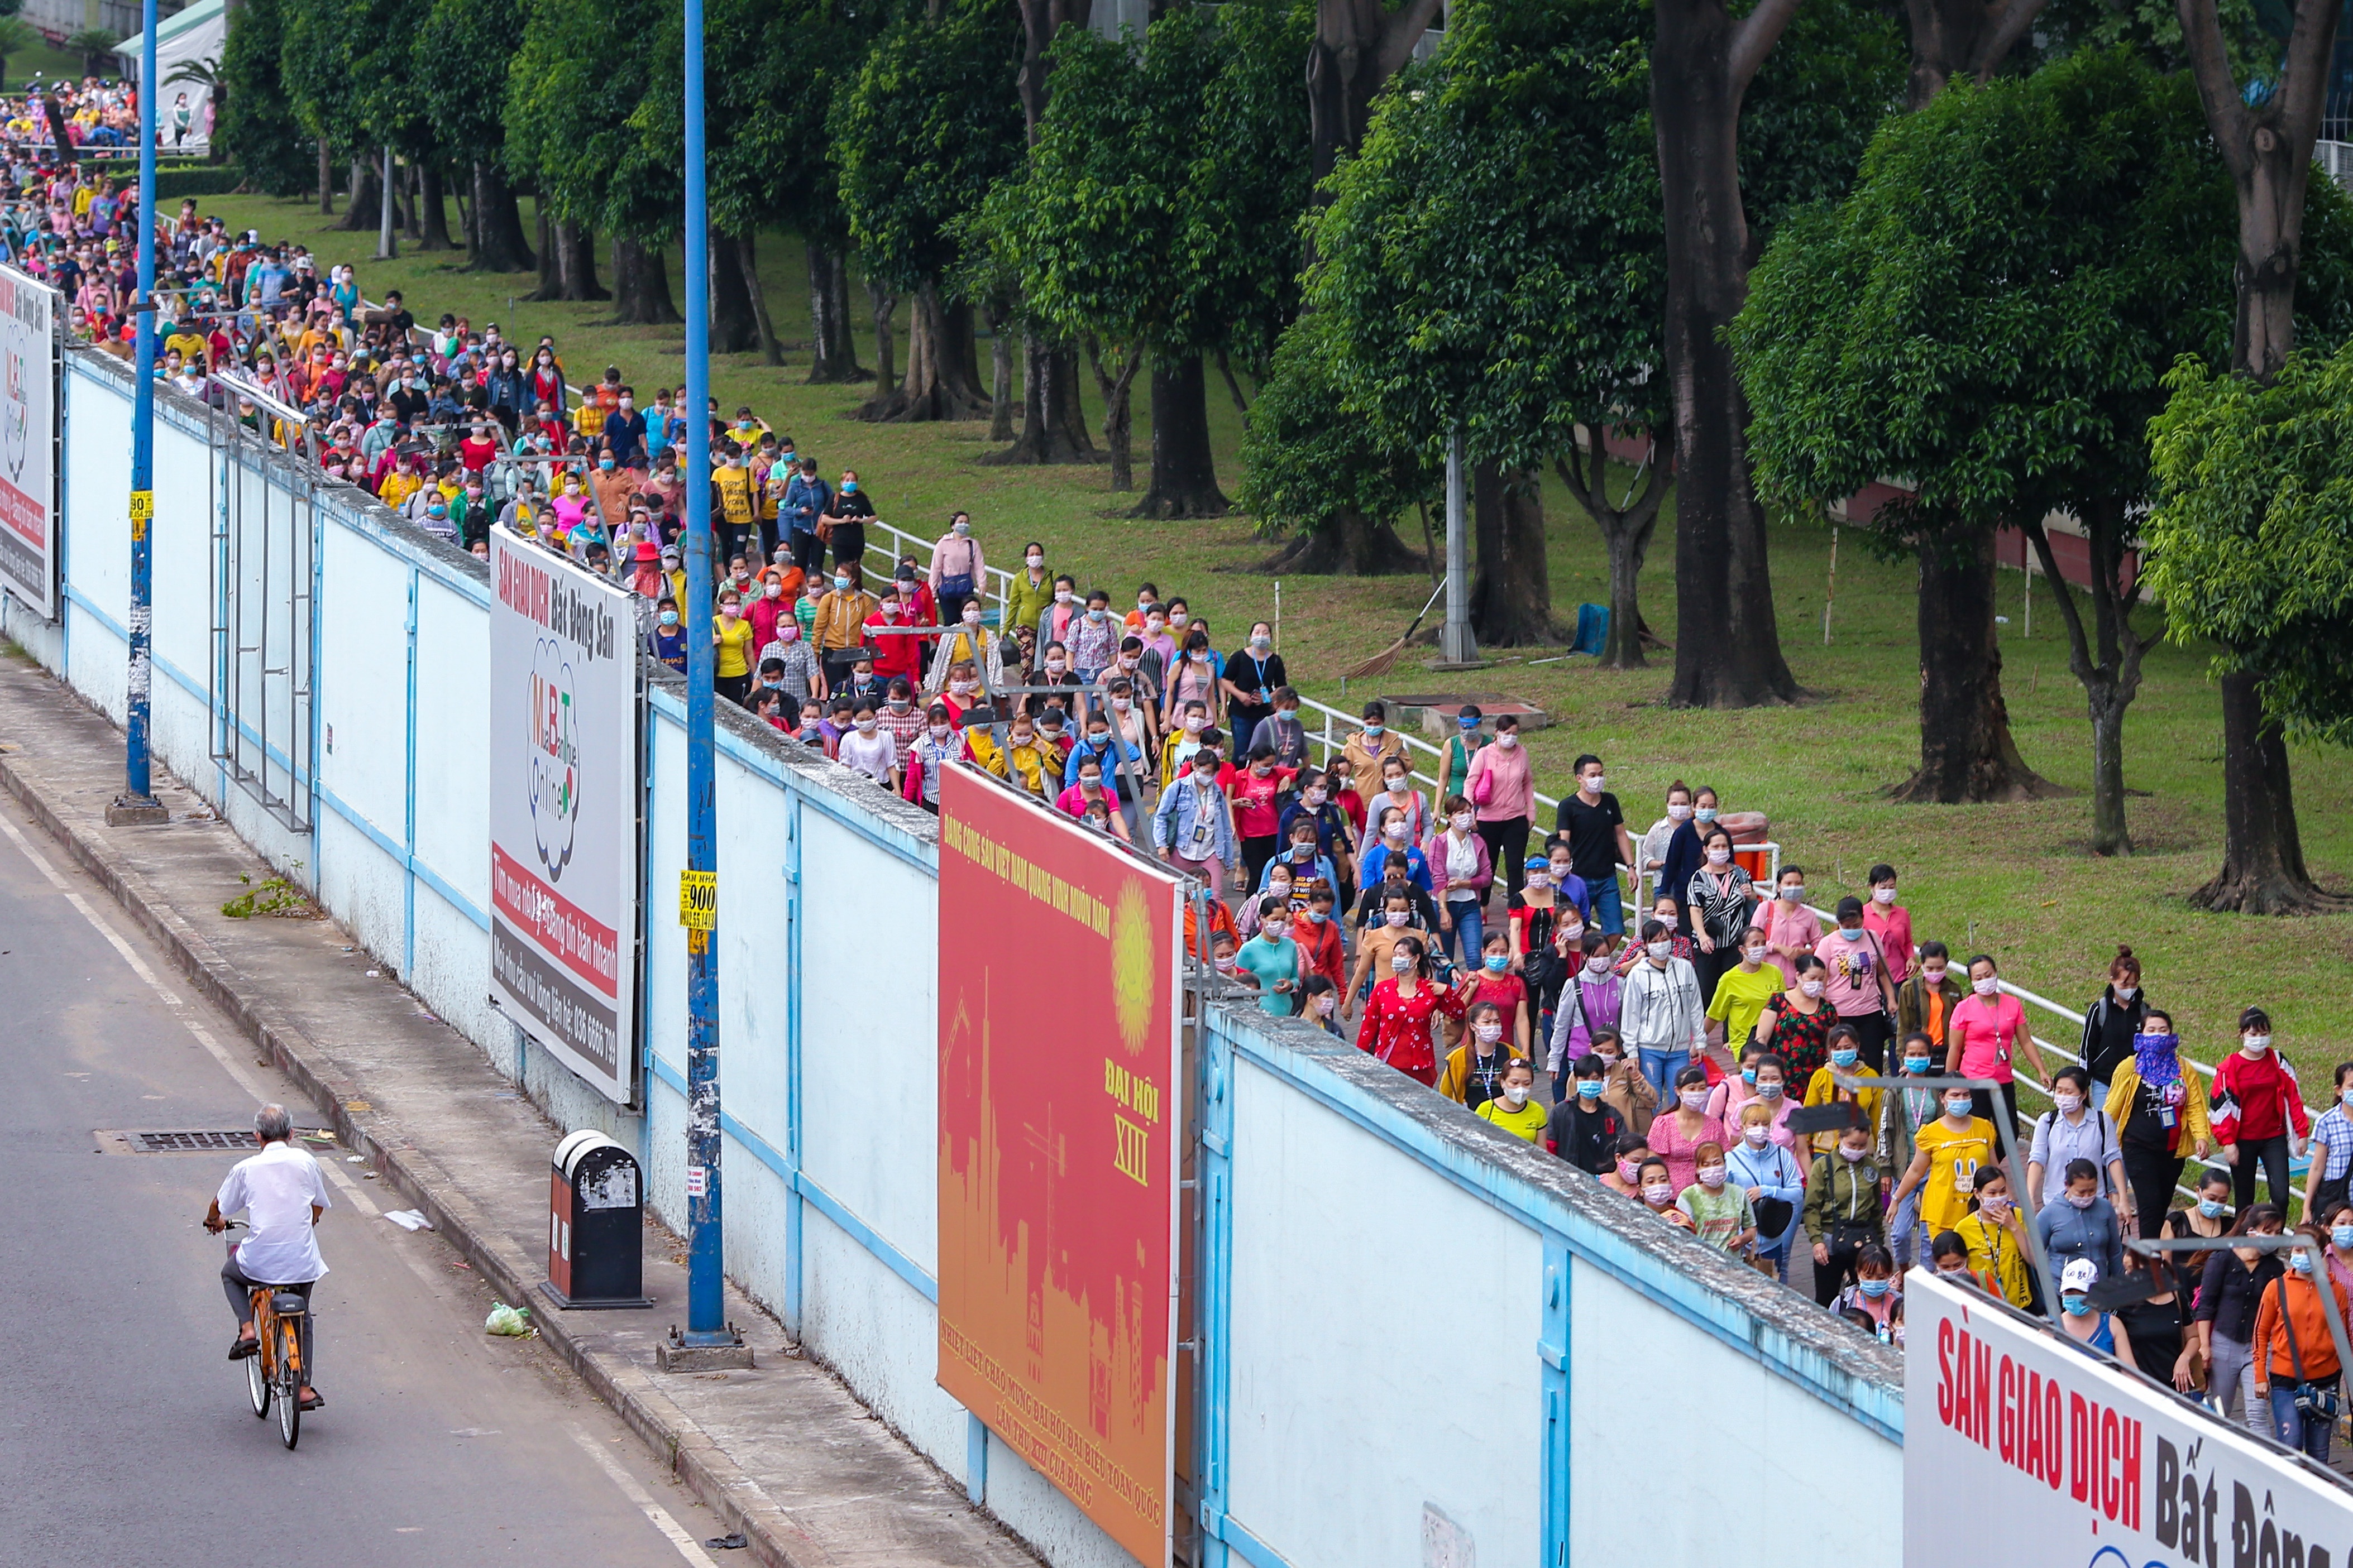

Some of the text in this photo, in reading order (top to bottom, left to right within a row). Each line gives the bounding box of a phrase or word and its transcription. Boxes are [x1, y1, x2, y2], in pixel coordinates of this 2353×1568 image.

[499, 539, 613, 664] SÀN GIAO DỊCH Bất Động Sản
[508, 875, 520, 912] mua
[566, 913, 576, 955] tin
[577, 918, 591, 965] bán
[593, 932, 616, 981] nhanh
[681, 871, 696, 882] BÁN
[690, 884, 716, 911] 900
[944, 807, 1110, 940] ĐẢNG CỘNG SẢN VIỆT NAM QUANG VINH MUÔN NĂM
[494, 934, 505, 980] Mọi
[505, 950, 516, 986] nhu
[516, 952, 527, 995] cầu
[527, 971, 536, 1003] vui
[537, 974, 551, 1024] lòng
[574, 1005, 587, 1044] 036
[587, 1014, 604, 1058] 6666
[605, 1027, 615, 1066] 799
[1105, 1057, 1159, 1126] ĐẠI HỘI
[1113, 1113, 1148, 1187] XIII
[941, 1316, 1160, 1528] NHIỆT LIỆT CHÀO MỪNG ĐẠI HỘI ĐẠI BIỂU TOÀN QUỐC
[995, 1399, 1093, 1509] LẦN THỨ XIII CỦA ĐẢNG
[1938, 1304, 1991, 1451] SÀN
[1998, 1354, 2063, 1490] GIAO
[2070, 1389, 2142, 1536] DỊCH
[2156, 1434, 2218, 1568] Bất
